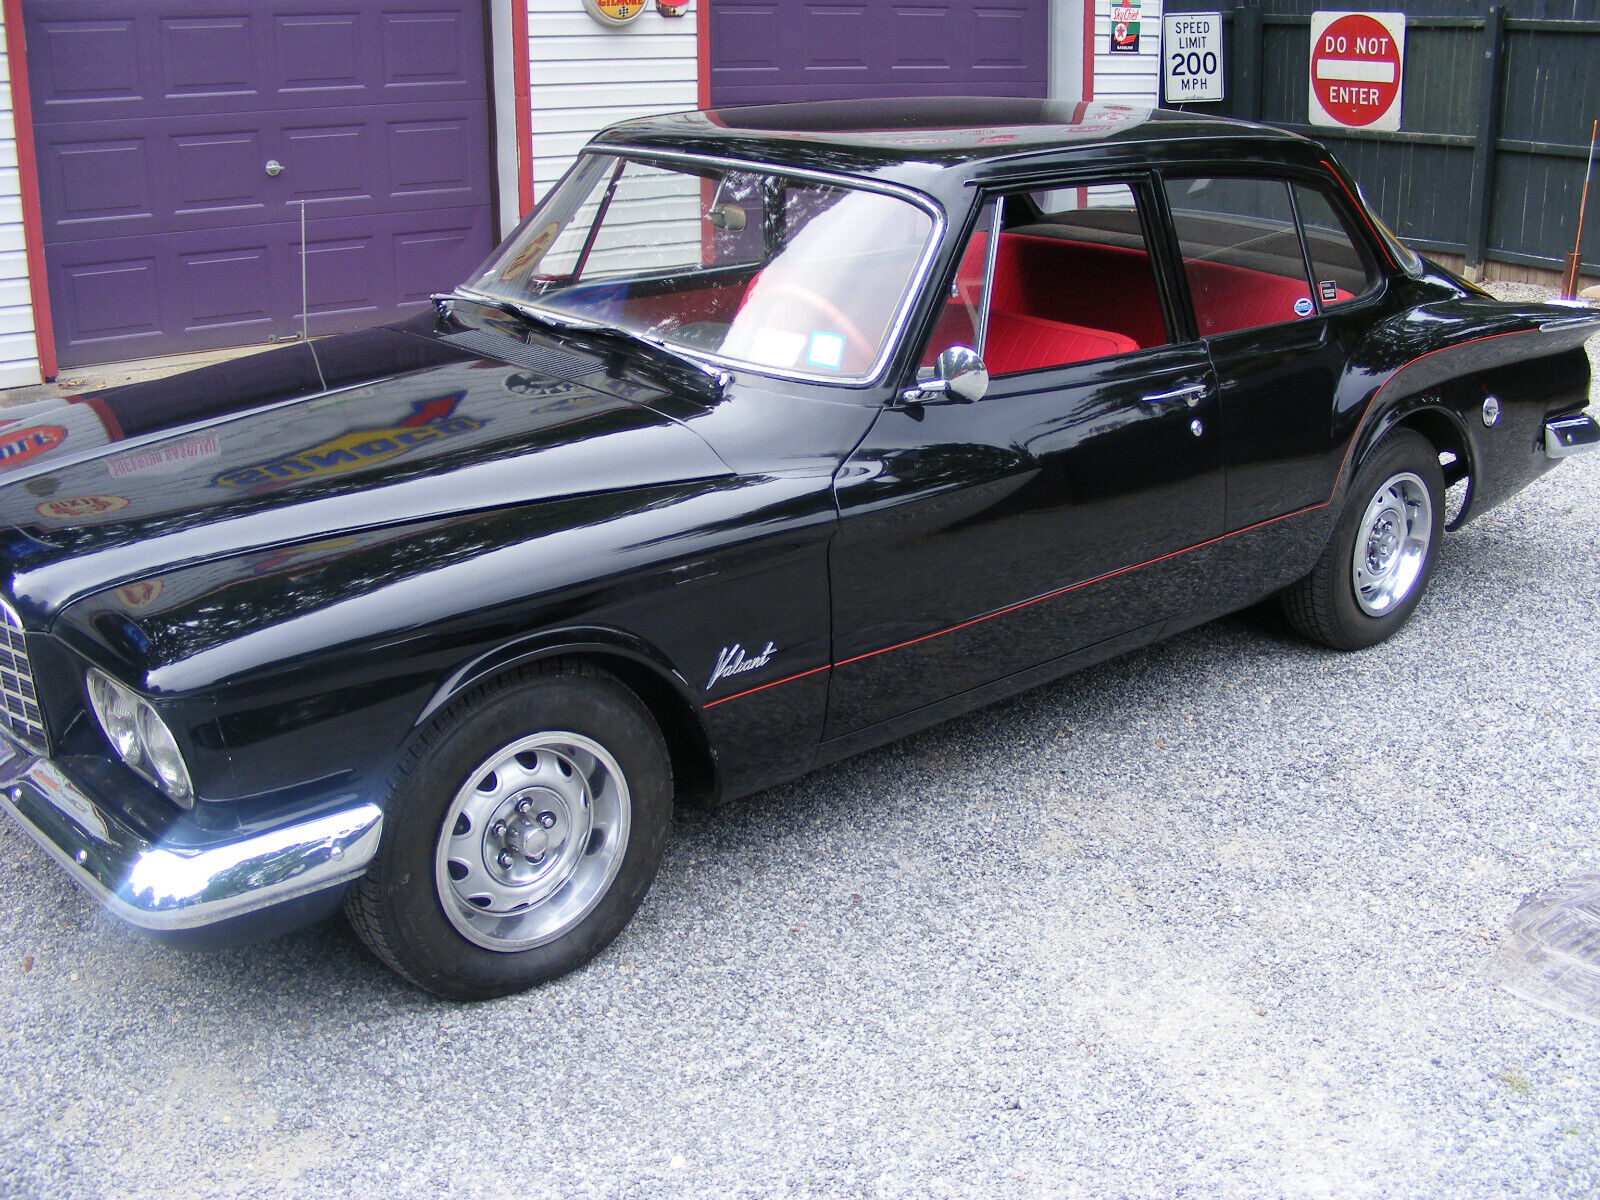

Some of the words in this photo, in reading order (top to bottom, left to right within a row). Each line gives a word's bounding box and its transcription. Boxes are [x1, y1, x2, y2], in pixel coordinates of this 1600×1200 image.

[1113, 7, 1124, 22] Sky
[1124, 8, 1139, 21] Chief
[1175, 22, 1210, 34] SPEED
[1179, 36, 1207, 49] LIMIT
[1325, 36, 1346, 53] DO
[1356, 37, 1388, 55] NOT
[1171, 52, 1217, 76] 200
[1181, 78, 1208, 91] MPH
[1329, 86, 1379, 106] ENTER
[706, 641, 778, 690] Valiant
